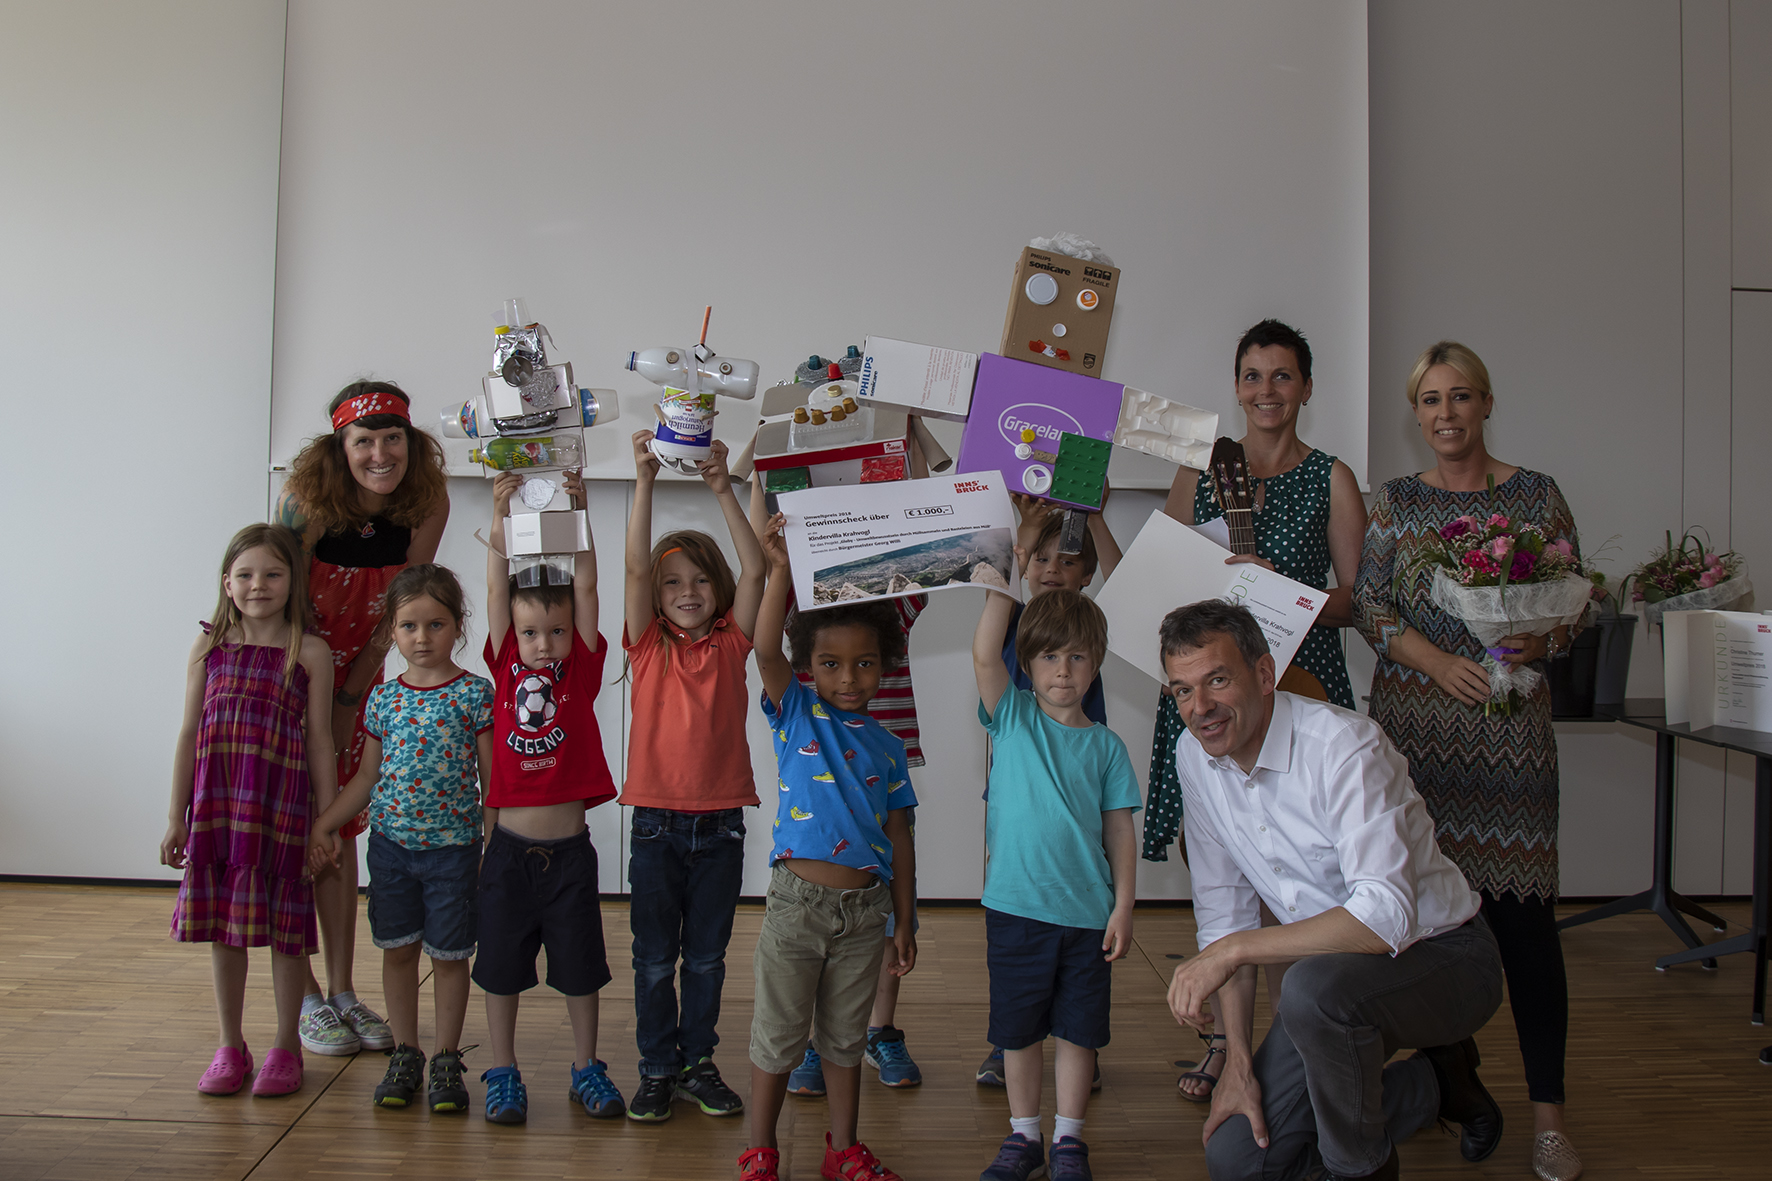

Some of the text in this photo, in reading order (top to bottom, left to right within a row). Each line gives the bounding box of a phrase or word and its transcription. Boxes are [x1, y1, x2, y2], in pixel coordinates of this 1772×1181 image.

[1030, 252, 1052, 262] PHILIPS
[1029, 260, 1071, 276] sonicare
[1082, 277, 1110, 288] FRAGILE
[860, 356, 874, 396] PHILIPS
[668, 420, 706, 432] Heumilch
[1004, 416, 1079, 441] Gracela
[956, 484, 990, 494] BRUCK
[805, 515, 868, 528] Gewinnscheck
[869, 513, 890, 521] über
[808, 529, 871, 542] Kindervilla Krahvogl
[1295, 600, 1315, 612] BRUCK
[1269, 620, 1295, 637] Krahvogl
[1714, 620, 1730, 710] URKUNDE
[506, 726, 566, 756] LEGEND
